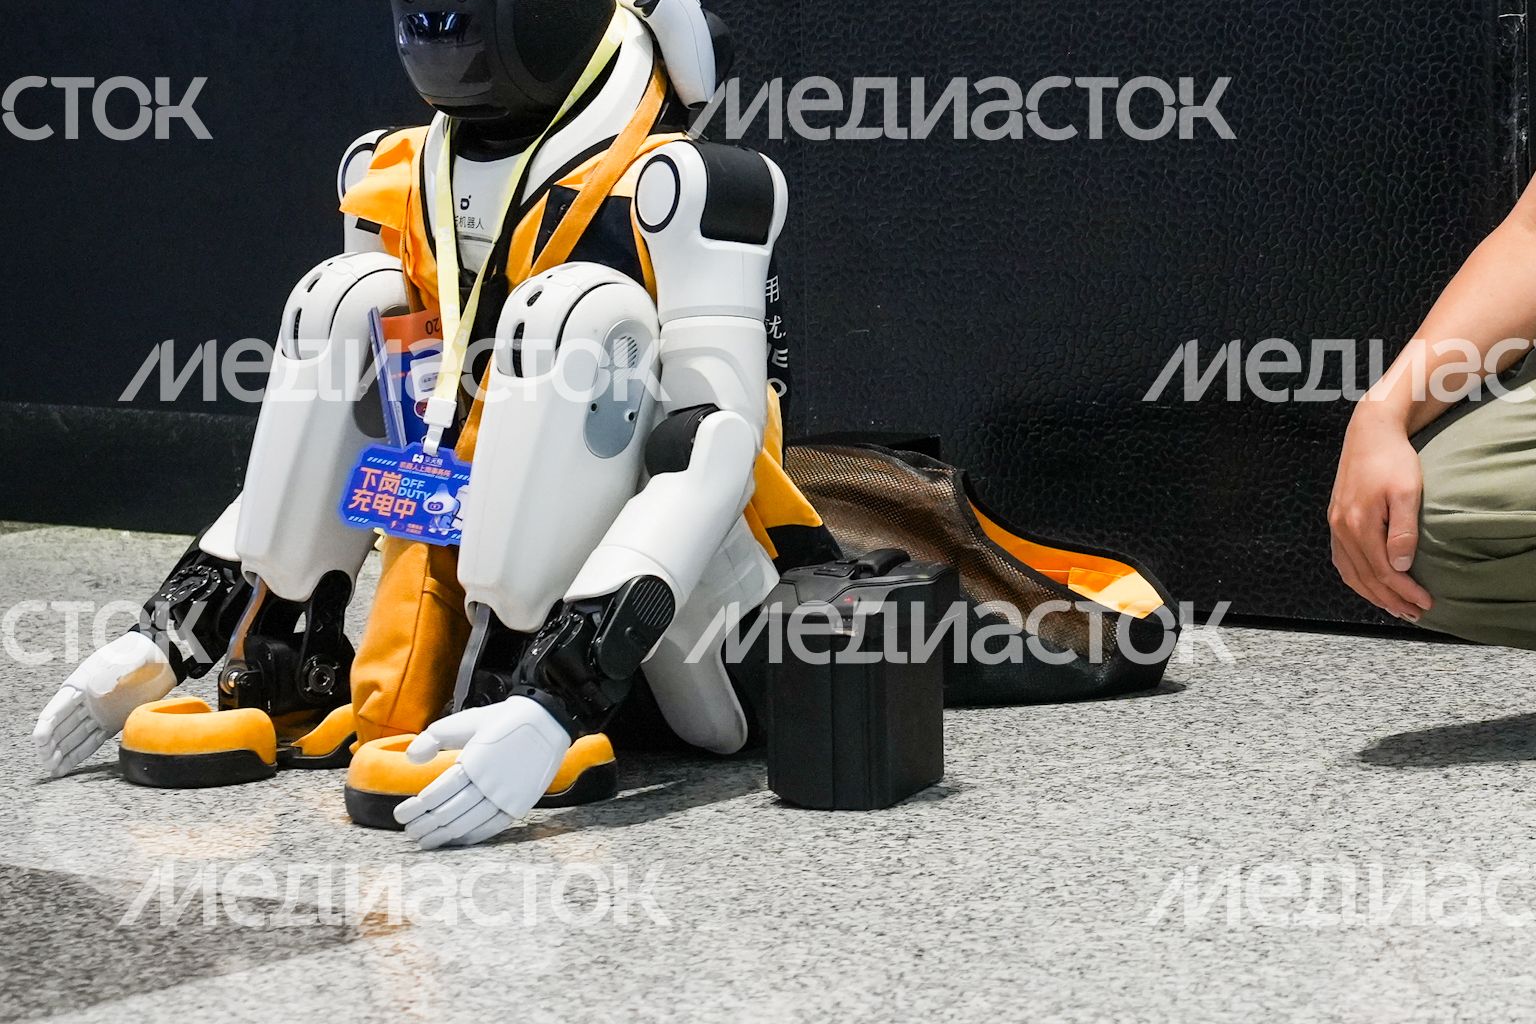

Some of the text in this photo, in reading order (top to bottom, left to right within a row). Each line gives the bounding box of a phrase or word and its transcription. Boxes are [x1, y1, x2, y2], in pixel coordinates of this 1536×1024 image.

[360, 466, 426, 494] 下岗 OFF
[348, 487, 431, 520] 充电中 DUTY
